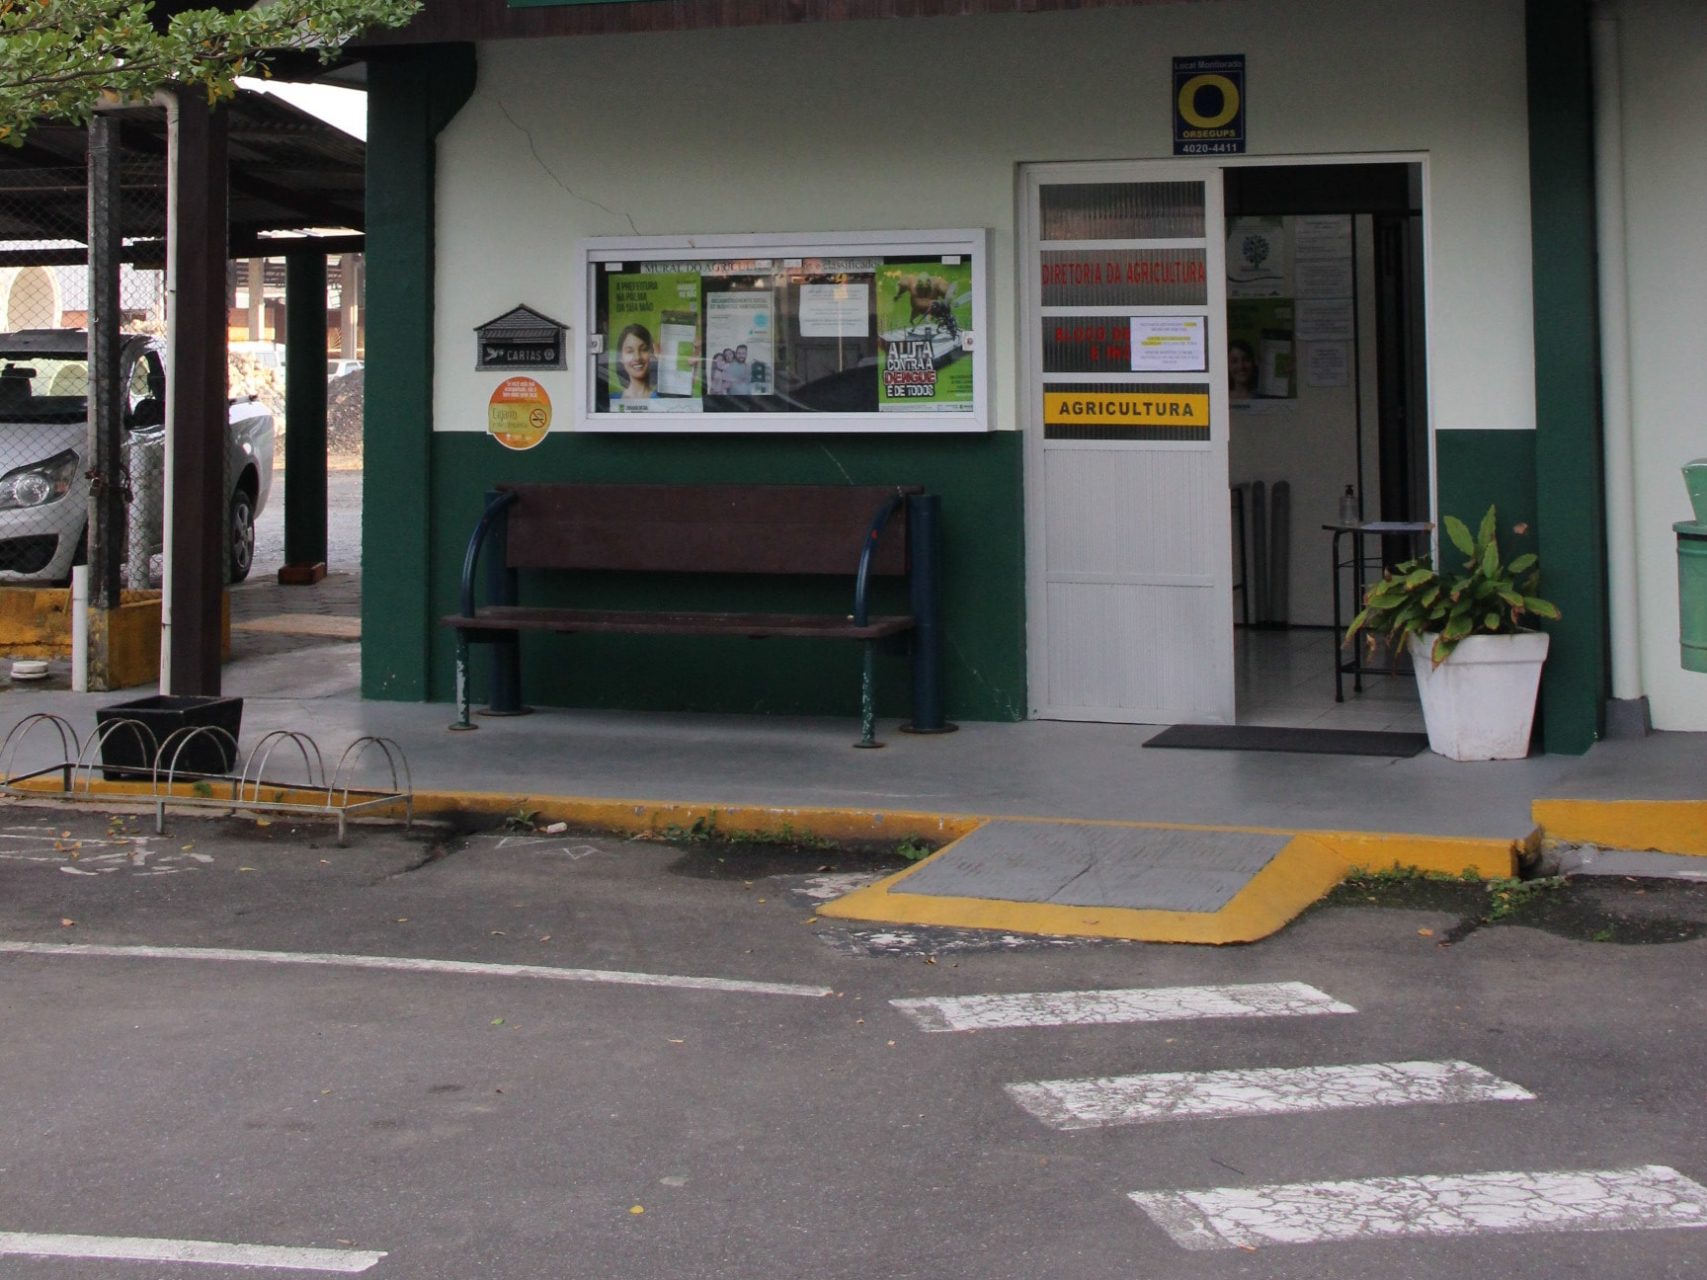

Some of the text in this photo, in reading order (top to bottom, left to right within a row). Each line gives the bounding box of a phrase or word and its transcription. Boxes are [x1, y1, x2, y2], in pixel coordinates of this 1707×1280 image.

[1182, 129, 1236, 138] ORSEGUPS
[1182, 143, 1237, 153] 4020-4411
[645, 262, 682, 272] MURAL
[687, 262, 701, 272] DO
[1042, 261, 1206, 285] DIRETORIA DA AGRICULTURA
[1056, 326, 1105, 342] BLOCO
[889, 341, 933, 358] A LUTA
[507, 350, 542, 361] CARTAS
[888, 359, 933, 370] CONTRA A
[885, 371, 936, 384] DENGUE
[895, 385, 905, 396] DE
[907, 385, 934, 396] TODOS
[1059, 401, 1194, 416] AGRICULTURA
